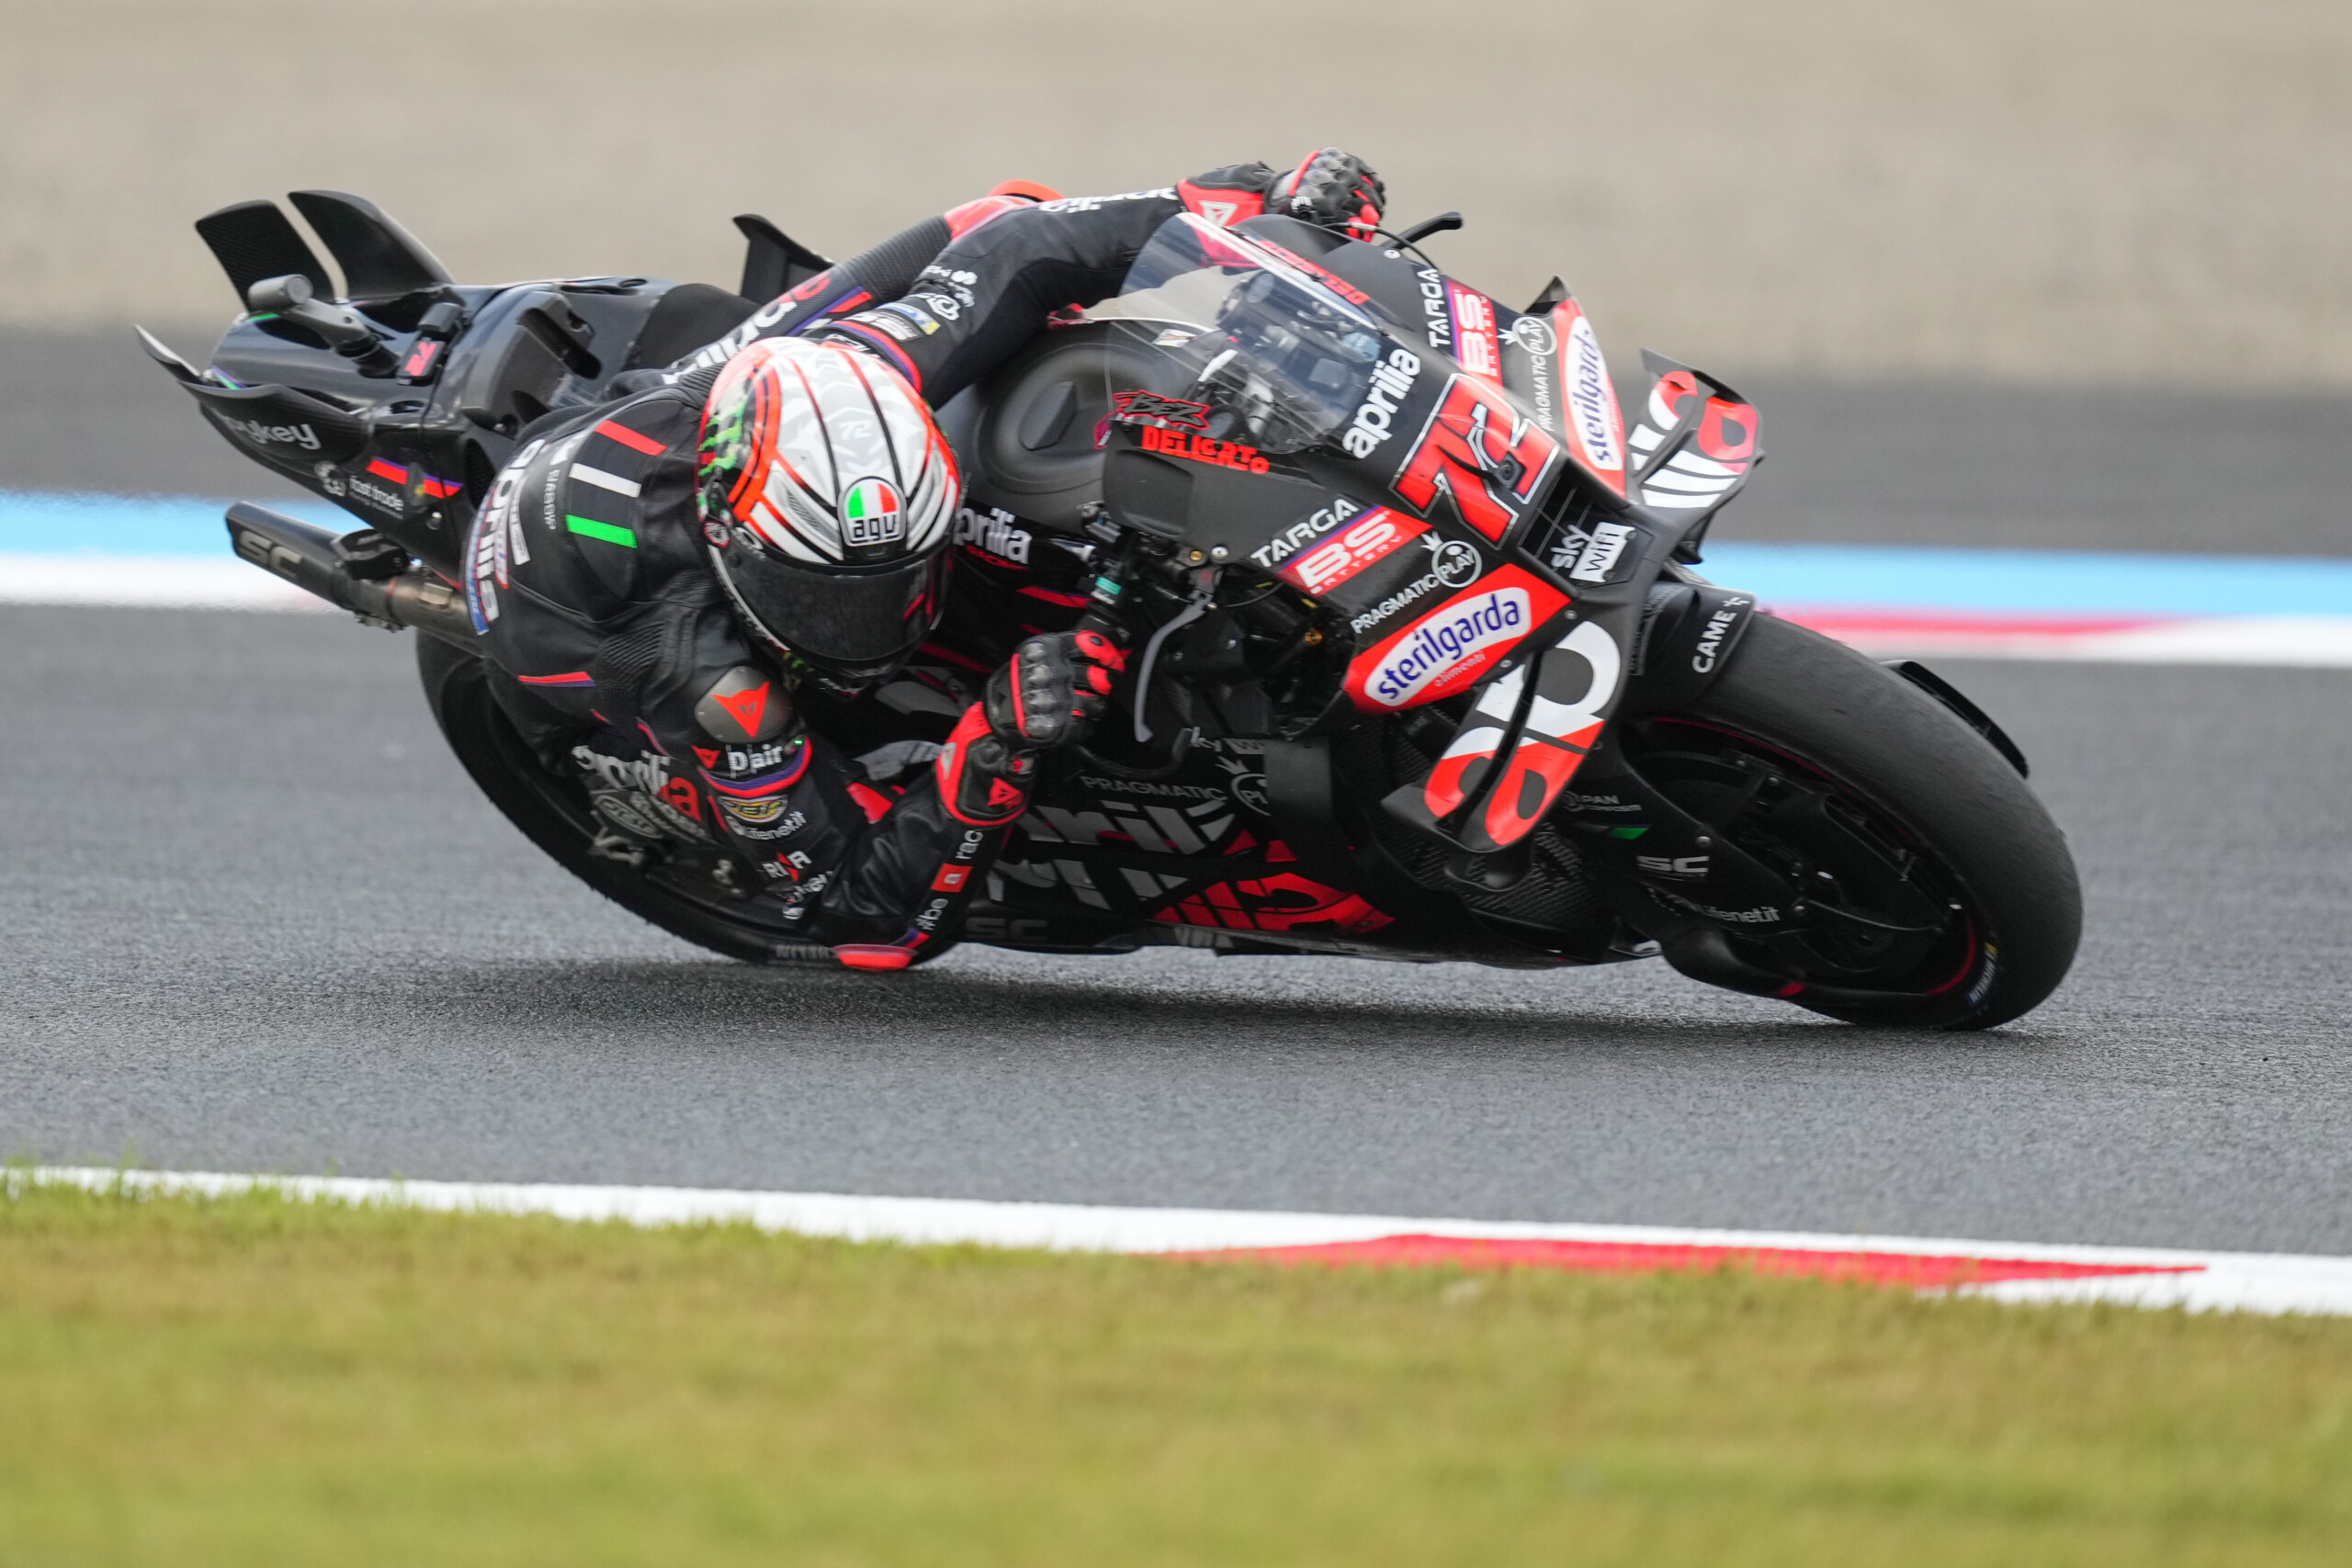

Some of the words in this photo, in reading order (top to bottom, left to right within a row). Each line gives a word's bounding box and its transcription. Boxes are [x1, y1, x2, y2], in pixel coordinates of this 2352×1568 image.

[1417, 267, 1451, 348] TARGA
[1453, 288, 1488, 376] BS
[1342, 347, 1421, 459] aprilia
[1530, 353, 1554, 432] PRAGMATIC
[1572, 328, 1612, 463] sterilgarda
[239, 529, 303, 579] SC
[851, 517, 901, 542] agv
[953, 507, 1034, 565] prilia
[1250, 498, 1360, 568] TARGA
[1295, 511, 1396, 588] BS
[1551, 524, 1592, 571] sky
[1351, 573, 1440, 634] PRAGMATIC
[1436, 551, 1476, 582] PLAY
[1377, 592, 1521, 700] sterilgarda
[1691, 610, 1738, 673] CAME
[1081, 776, 1227, 801] PRAGMATIC
[956, 829, 984, 861] rac
[1636, 855, 1710, 874] SC
